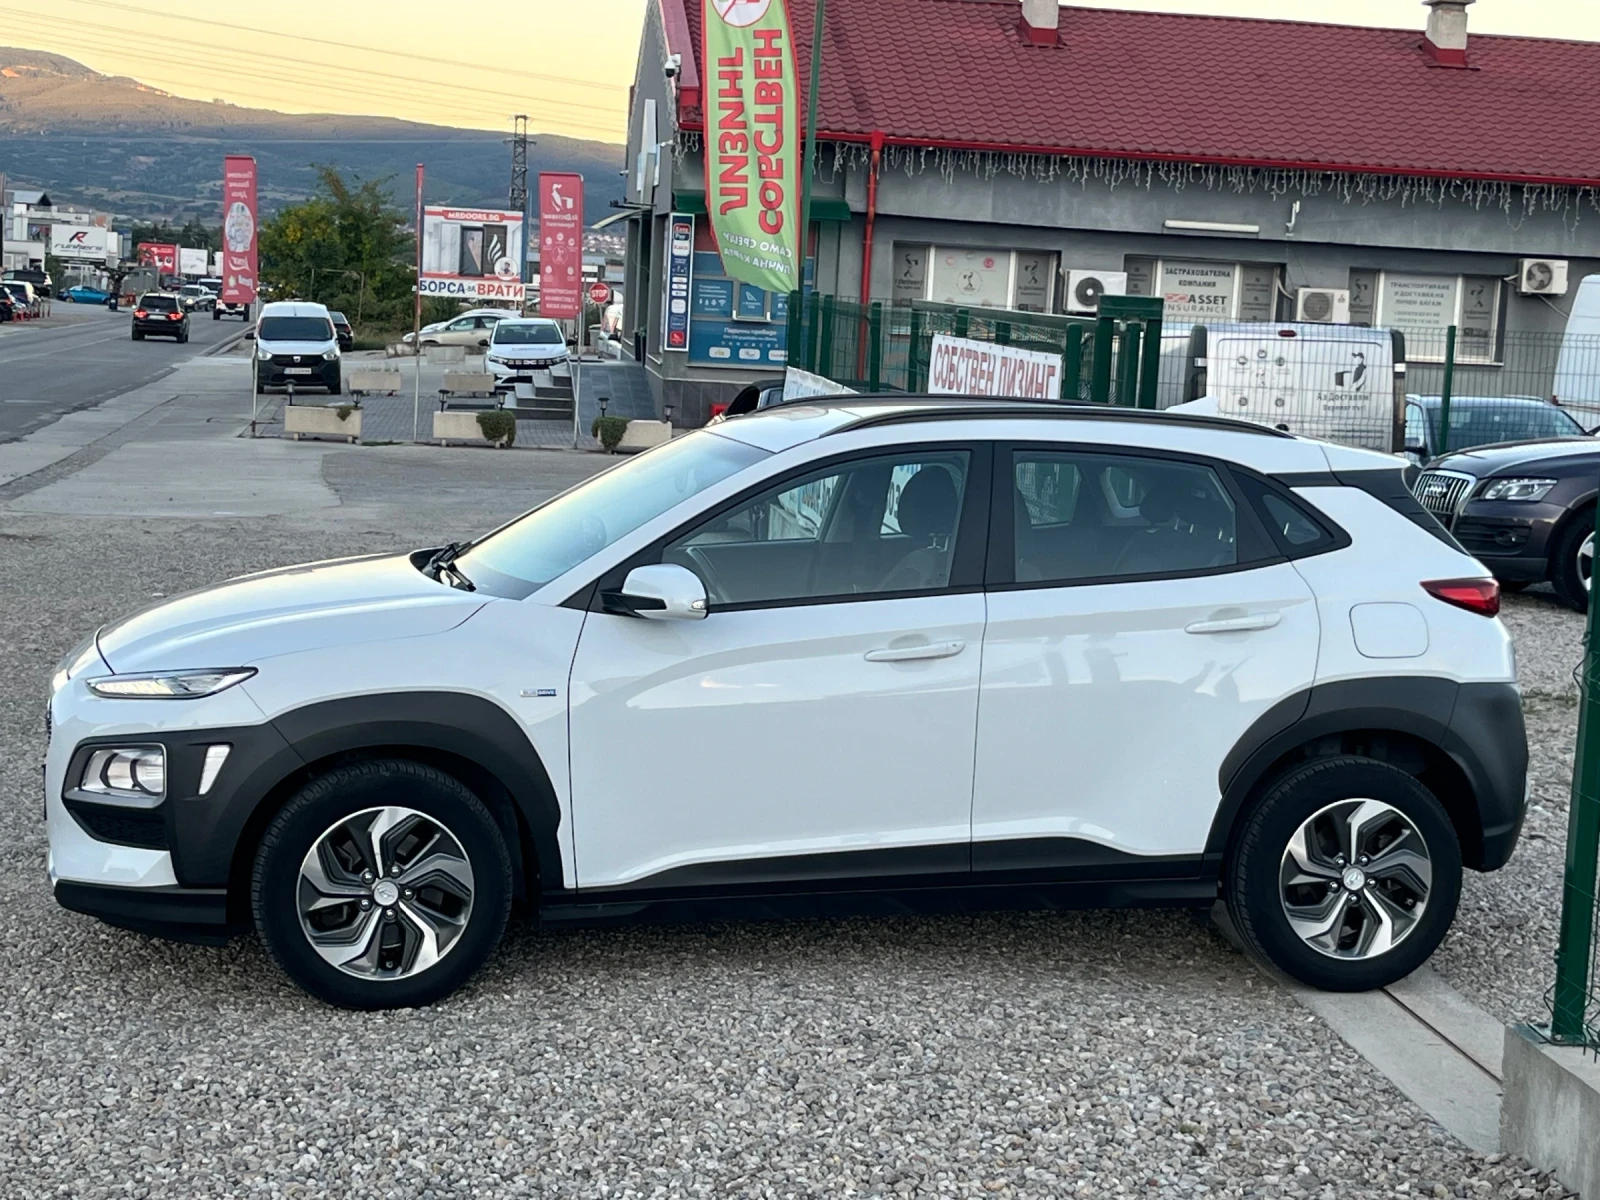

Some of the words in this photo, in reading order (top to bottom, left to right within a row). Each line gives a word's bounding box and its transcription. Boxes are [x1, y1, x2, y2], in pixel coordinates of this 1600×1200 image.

[1165, 267, 1231, 278] ЗАСТРАХОВАТЕЛНА
[419, 280, 466, 295] БОРСА
[477, 284, 524, 298] ВРАТИ
[1178, 279, 1217, 288] КОМПАНИЯ
[1390, 281, 1450, 291] ТРАНСПОРТИРАНЕ
[591, 289, 608, 298] STOP
[1187, 294, 1228, 305] ASSET
[1163, 303, 1228, 314] INSURANCE
[933, 343, 997, 397] СОБСТВЕН
[997, 355, 1057, 400] ЛИЗИНГ
